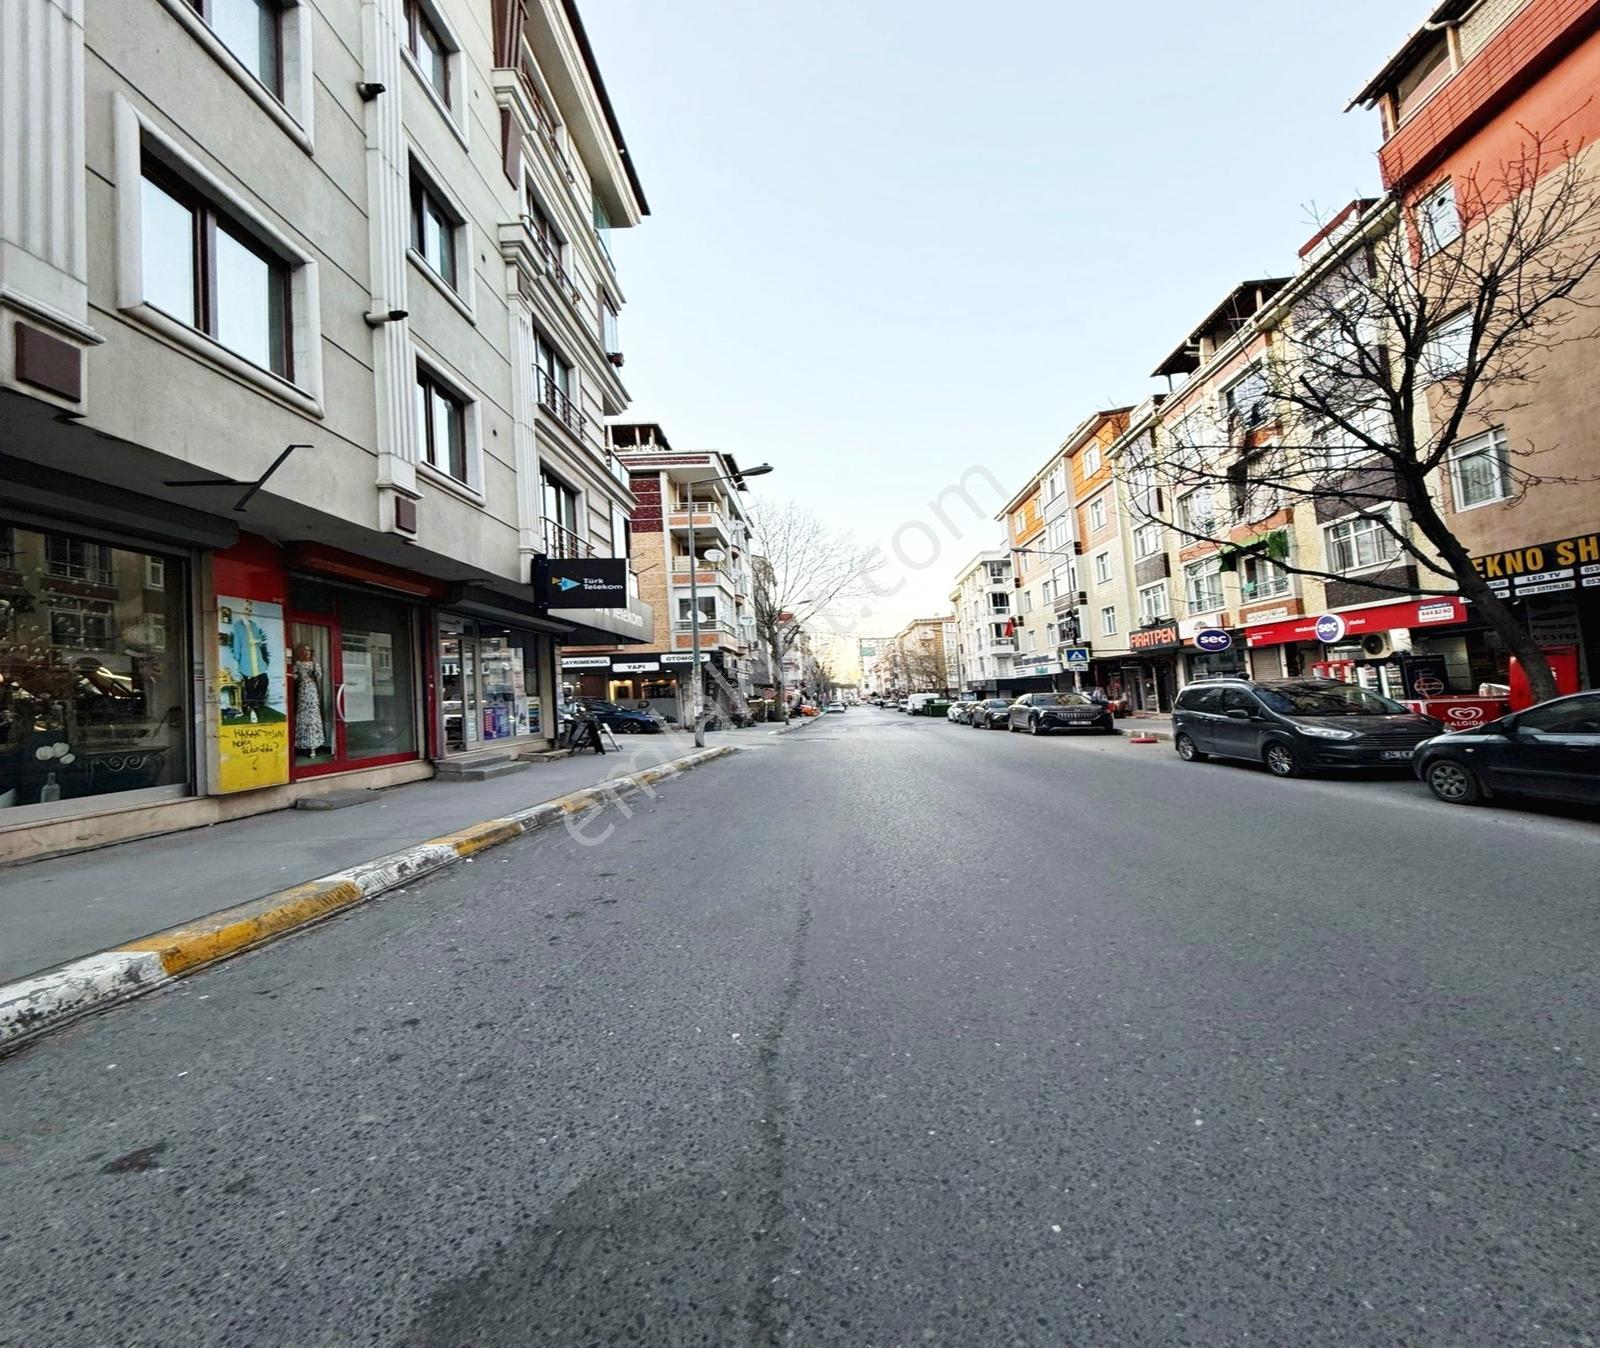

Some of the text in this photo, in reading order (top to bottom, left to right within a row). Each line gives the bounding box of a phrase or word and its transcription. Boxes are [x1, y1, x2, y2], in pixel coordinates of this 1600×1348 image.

[1471, 547, 1543, 578] EKNO
[1527, 571, 1561, 582] LED TV
